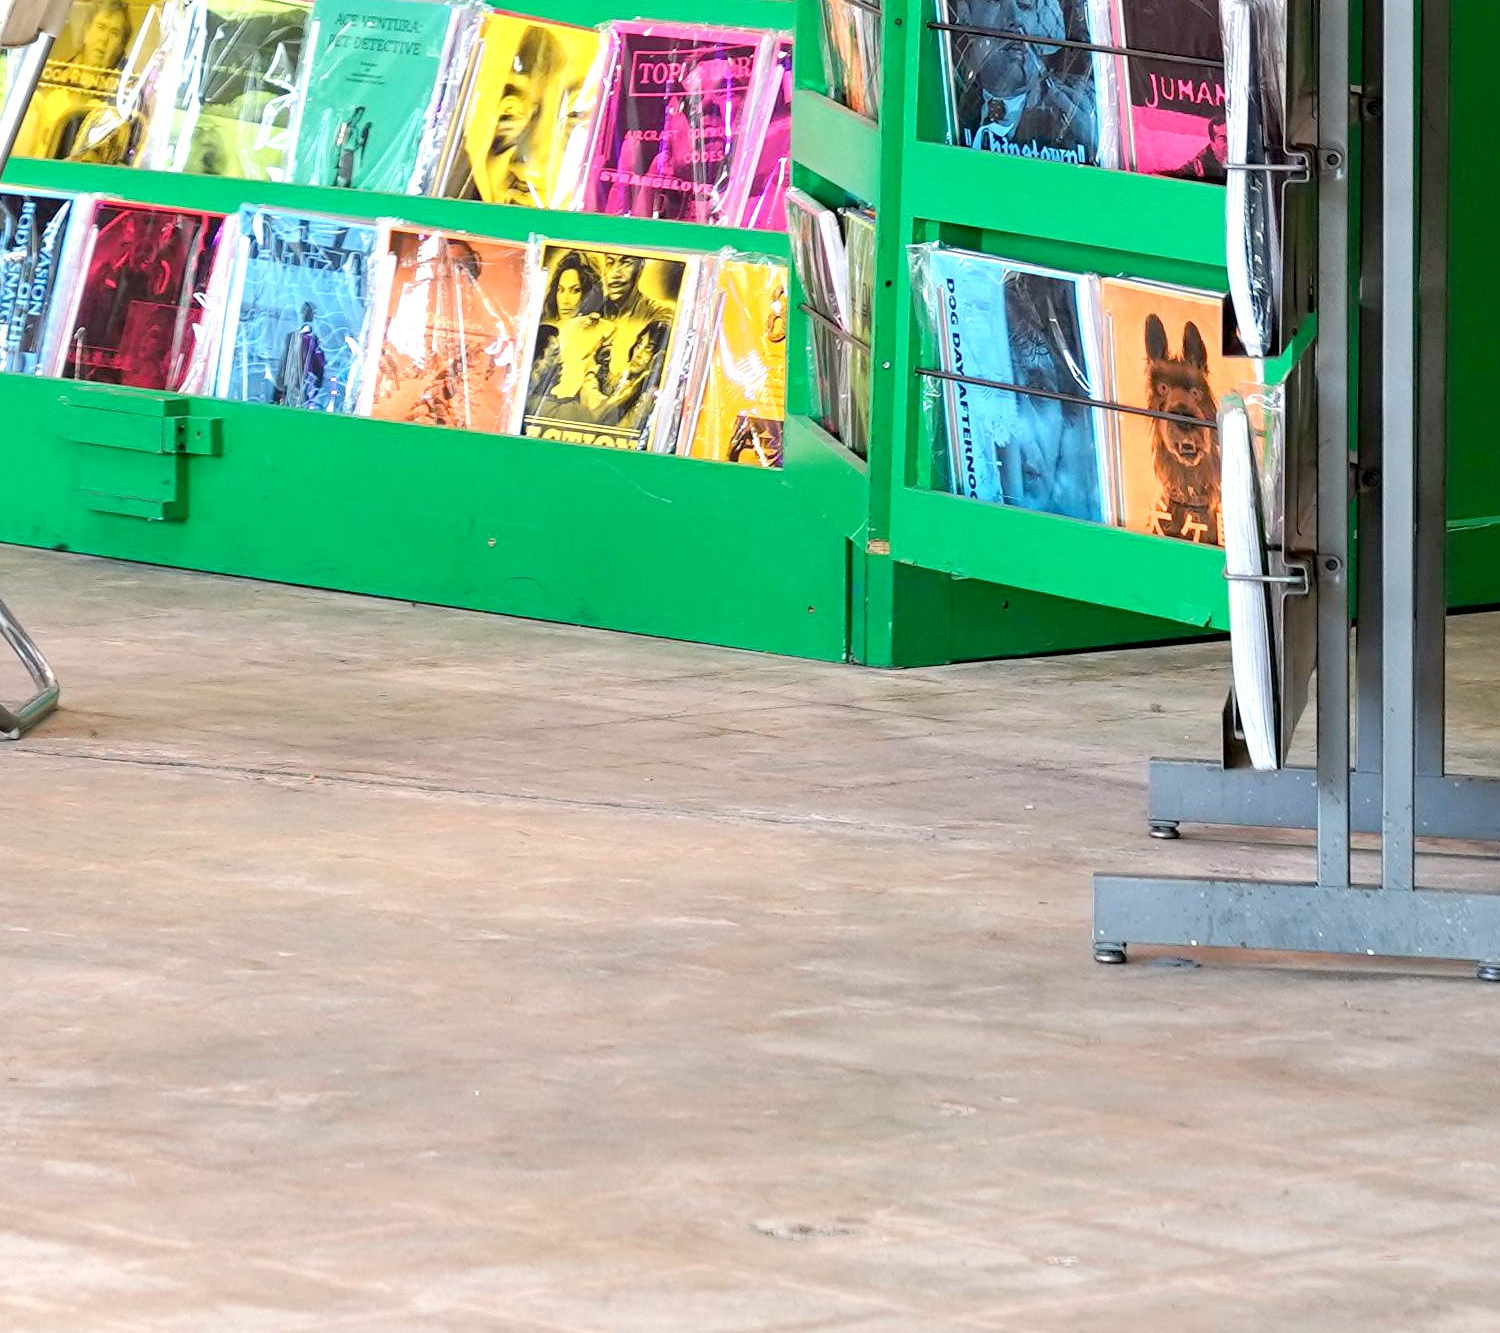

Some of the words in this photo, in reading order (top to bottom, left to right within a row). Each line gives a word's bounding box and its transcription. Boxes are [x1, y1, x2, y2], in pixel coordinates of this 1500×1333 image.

[334, 13, 360, 29] ACE
[353, 36, 423, 57] DETECTIVE
[639, 61, 682, 85] TOP
[1145, 73, 1229, 108] JUMAN
[599, 170, 716, 193] STRANGELOVE
[946, 278, 960, 327] DOG
[951, 331, 967, 378] DAY
